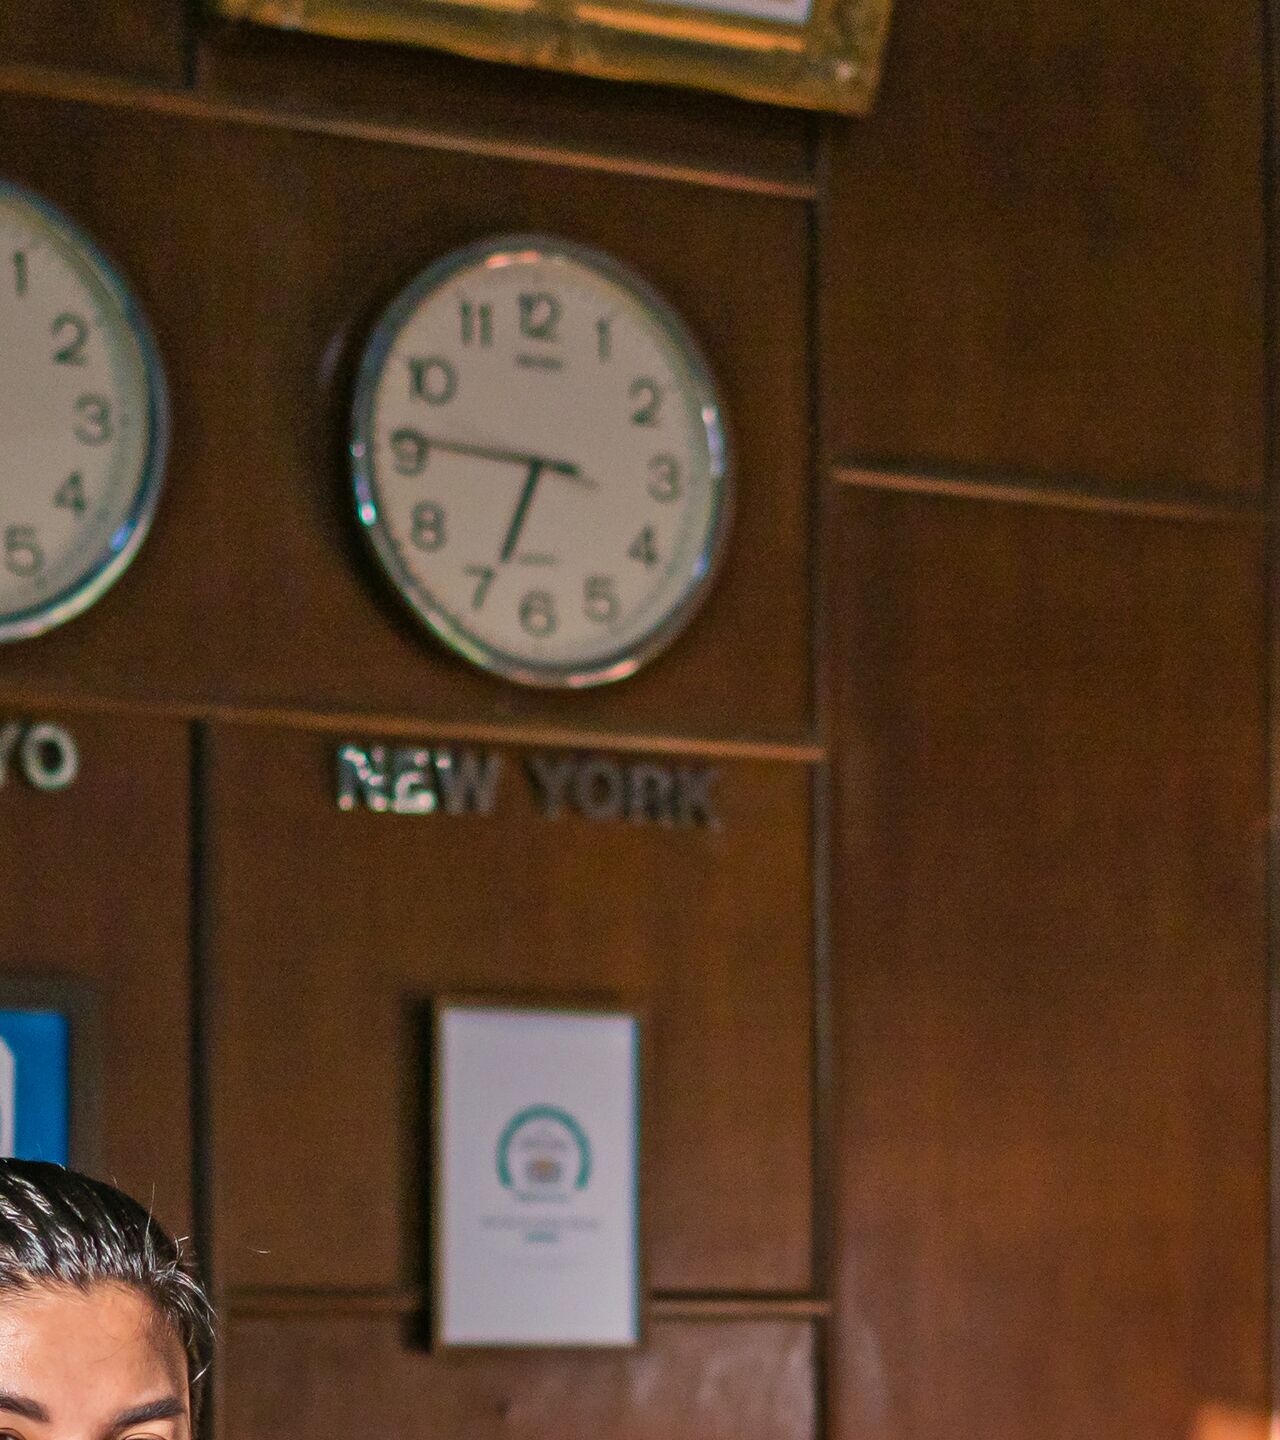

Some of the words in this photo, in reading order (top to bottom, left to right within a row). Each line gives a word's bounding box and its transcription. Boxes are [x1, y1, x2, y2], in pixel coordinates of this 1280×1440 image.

[13, 251, 27, 296] 1
[51, 312, 88, 365] 2
[459, 301, 493, 348] 11
[517, 292, 562, 342] 12
[596, 317, 612, 363] 1
[408, 355, 458, 405] 10
[629, 375, 661, 428] 2
[73, 394, 113, 447] 3
[390, 428, 428, 477] 9
[53, 471, 87, 519] 4
[646, 453, 681, 503] 3
[3, 525, 44, 577] 5
[410, 502, 446, 552] 8
[628, 525, 658, 569] 4
[464, 566, 496, 610] 7
[583, 575, 619, 624] 5
[520, 590, 558, 637] 6
[337, 745, 501, 815] NEW
[530, 757, 721, 832] YORK
